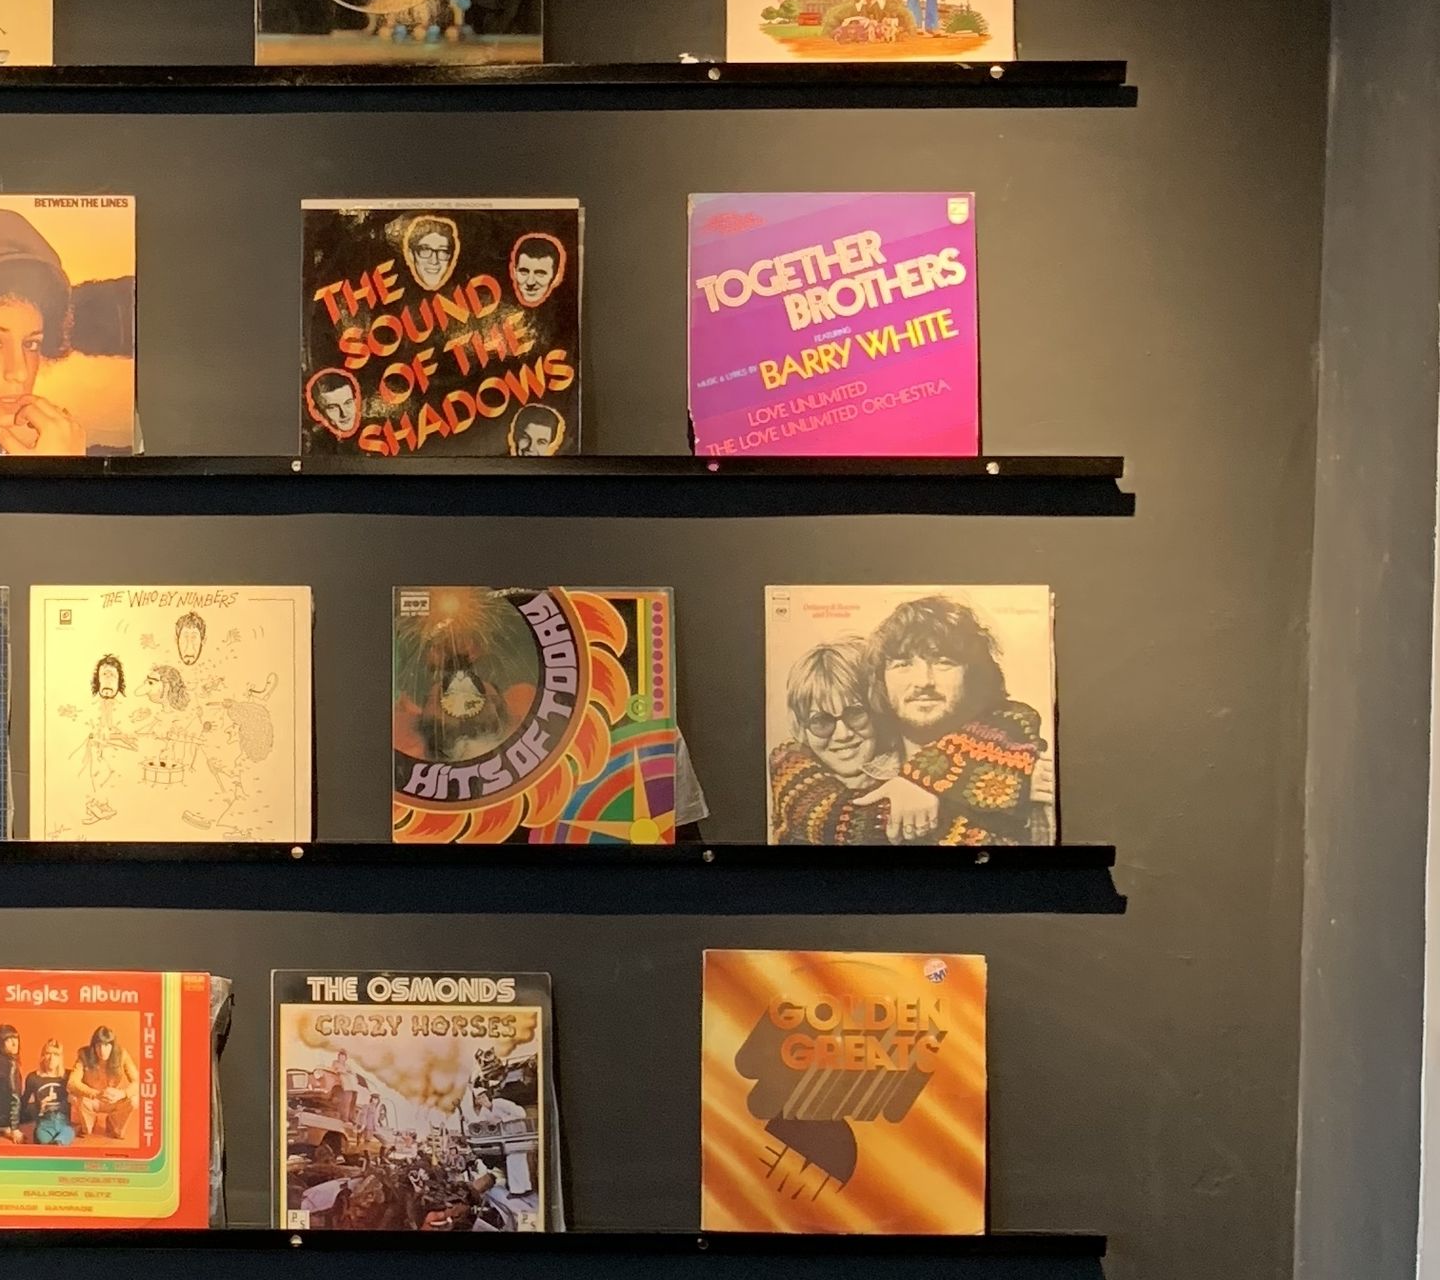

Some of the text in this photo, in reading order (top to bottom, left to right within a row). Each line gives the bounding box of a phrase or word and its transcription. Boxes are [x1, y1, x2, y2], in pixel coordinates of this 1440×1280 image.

[34, 199, 128, 208] BETWEEN THE LINES
[313, 259, 405, 326] THE
[696, 230, 886, 312] TOGETHER
[784, 247, 966, 331] BROTHERS
[339, 274, 502, 370] SOUND
[760, 308, 960, 390] BARRY WHITE
[814, 326, 852, 342] FEATURING
[379, 311, 536, 404] OF THE
[359, 348, 575, 456] SHADOWS
[706, 379, 952, 456] THE LOVE UNLIMITED ORCHESTRA
[748, 380, 868, 427] LOVE UNLIMITED
[100, 590, 239, 608] THE WHO BY NUMBERS
[518, 590, 578, 721] TODAY
[506, 720, 551, 778] OF
[6, 985, 68, 1005] Singles
[80, 986, 138, 1003] Album
[307, 976, 516, 1002] THE OSMONDS
[767, 994, 950, 1032] GOLDEN
[314, 1014, 517, 1038] CRAZY HORSES
[780, 1033, 940, 1072] GREATS
[141, 1012, 156, 1147] THE SWEET
